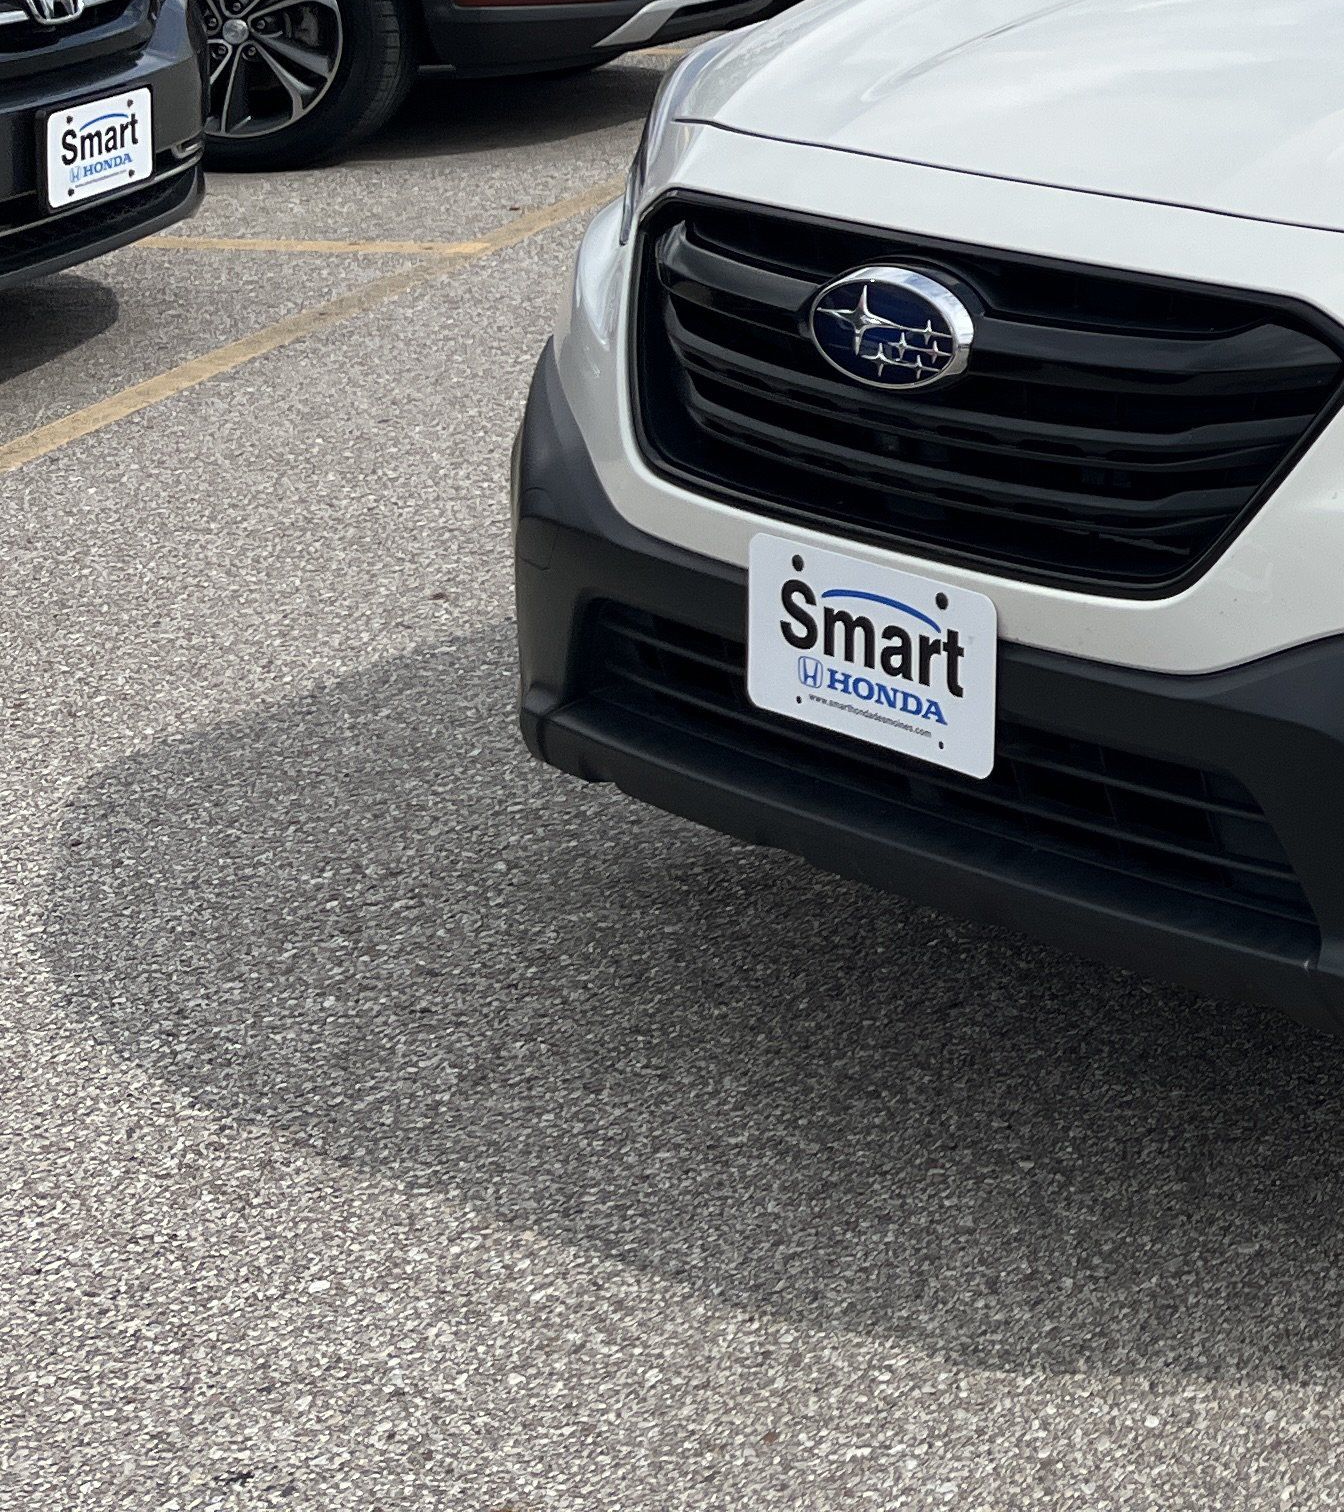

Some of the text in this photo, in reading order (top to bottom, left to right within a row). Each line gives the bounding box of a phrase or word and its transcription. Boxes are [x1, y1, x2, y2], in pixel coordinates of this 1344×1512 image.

[61, 113, 138, 166] Smart
[82, 153, 133, 177] HONDA
[780, 579, 964, 698] Smart
[827, 668, 948, 725] HONDA
